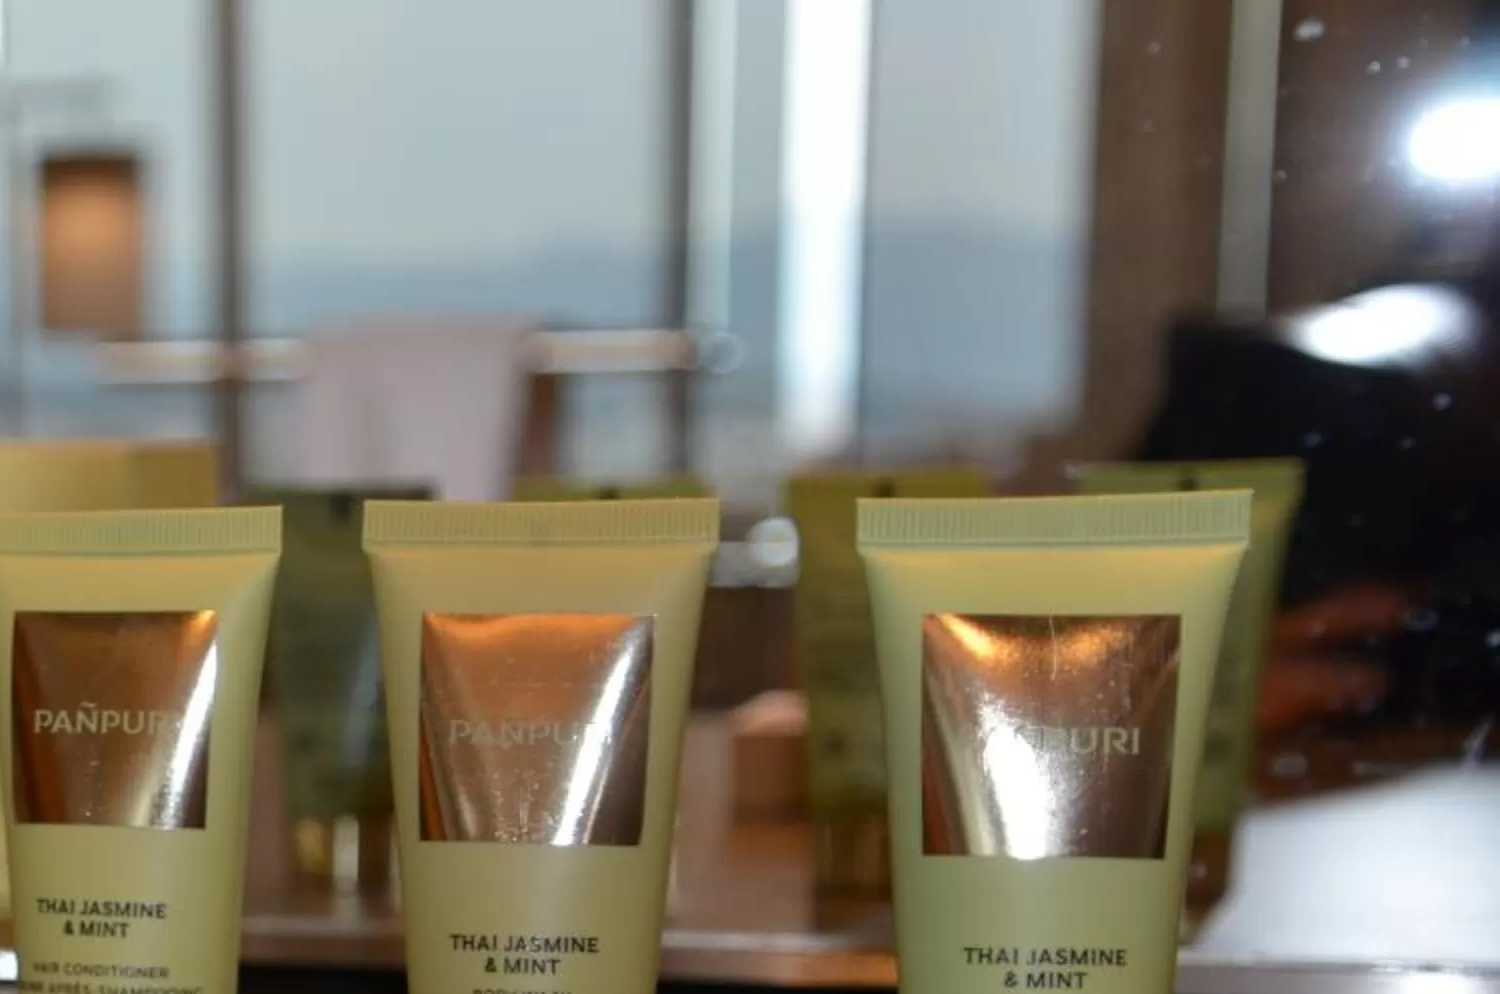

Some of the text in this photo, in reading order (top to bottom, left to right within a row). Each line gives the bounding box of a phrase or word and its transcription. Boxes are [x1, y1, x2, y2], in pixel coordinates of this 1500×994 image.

[34, 701, 179, 735] PAÑPUR
[36, 899, 168, 919] THAI JASMINE
[79, 921, 130, 938] MINT
[450, 934, 600, 953] THAI JASMINE
[964, 947, 1128, 966] THAI JASMINE
[63, 963, 170, 979] CONDITIONER
[484, 957, 561, 975] & MINT
[1004, 971, 1088, 989] & MINT
